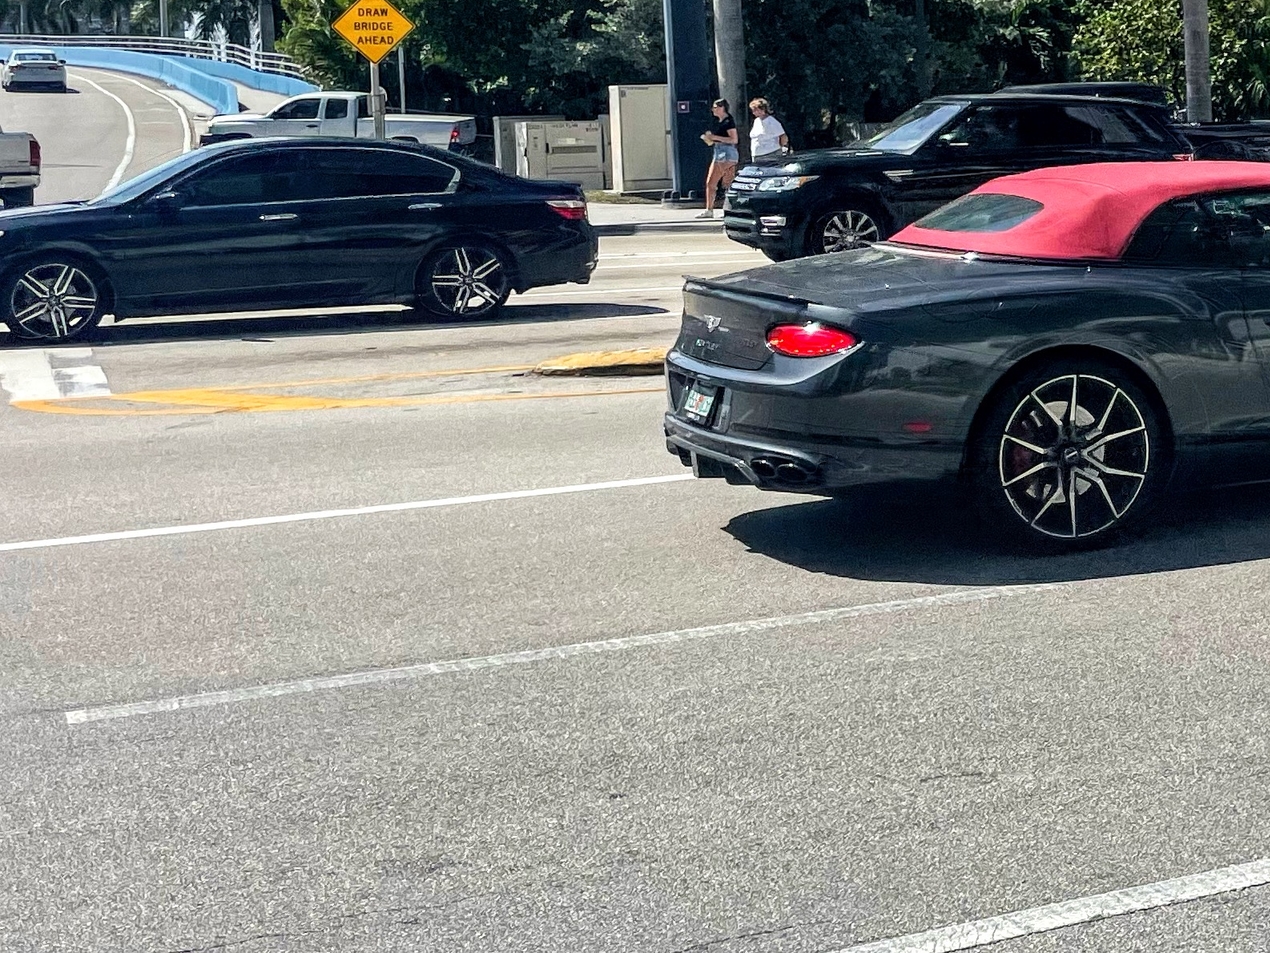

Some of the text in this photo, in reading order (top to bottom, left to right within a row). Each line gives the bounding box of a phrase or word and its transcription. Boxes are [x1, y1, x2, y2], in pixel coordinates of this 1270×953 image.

[358, 8, 388, 16] DRAW
[354, 22, 393, 31] BRIDGE
[357, 36, 394, 45] AHEAD
